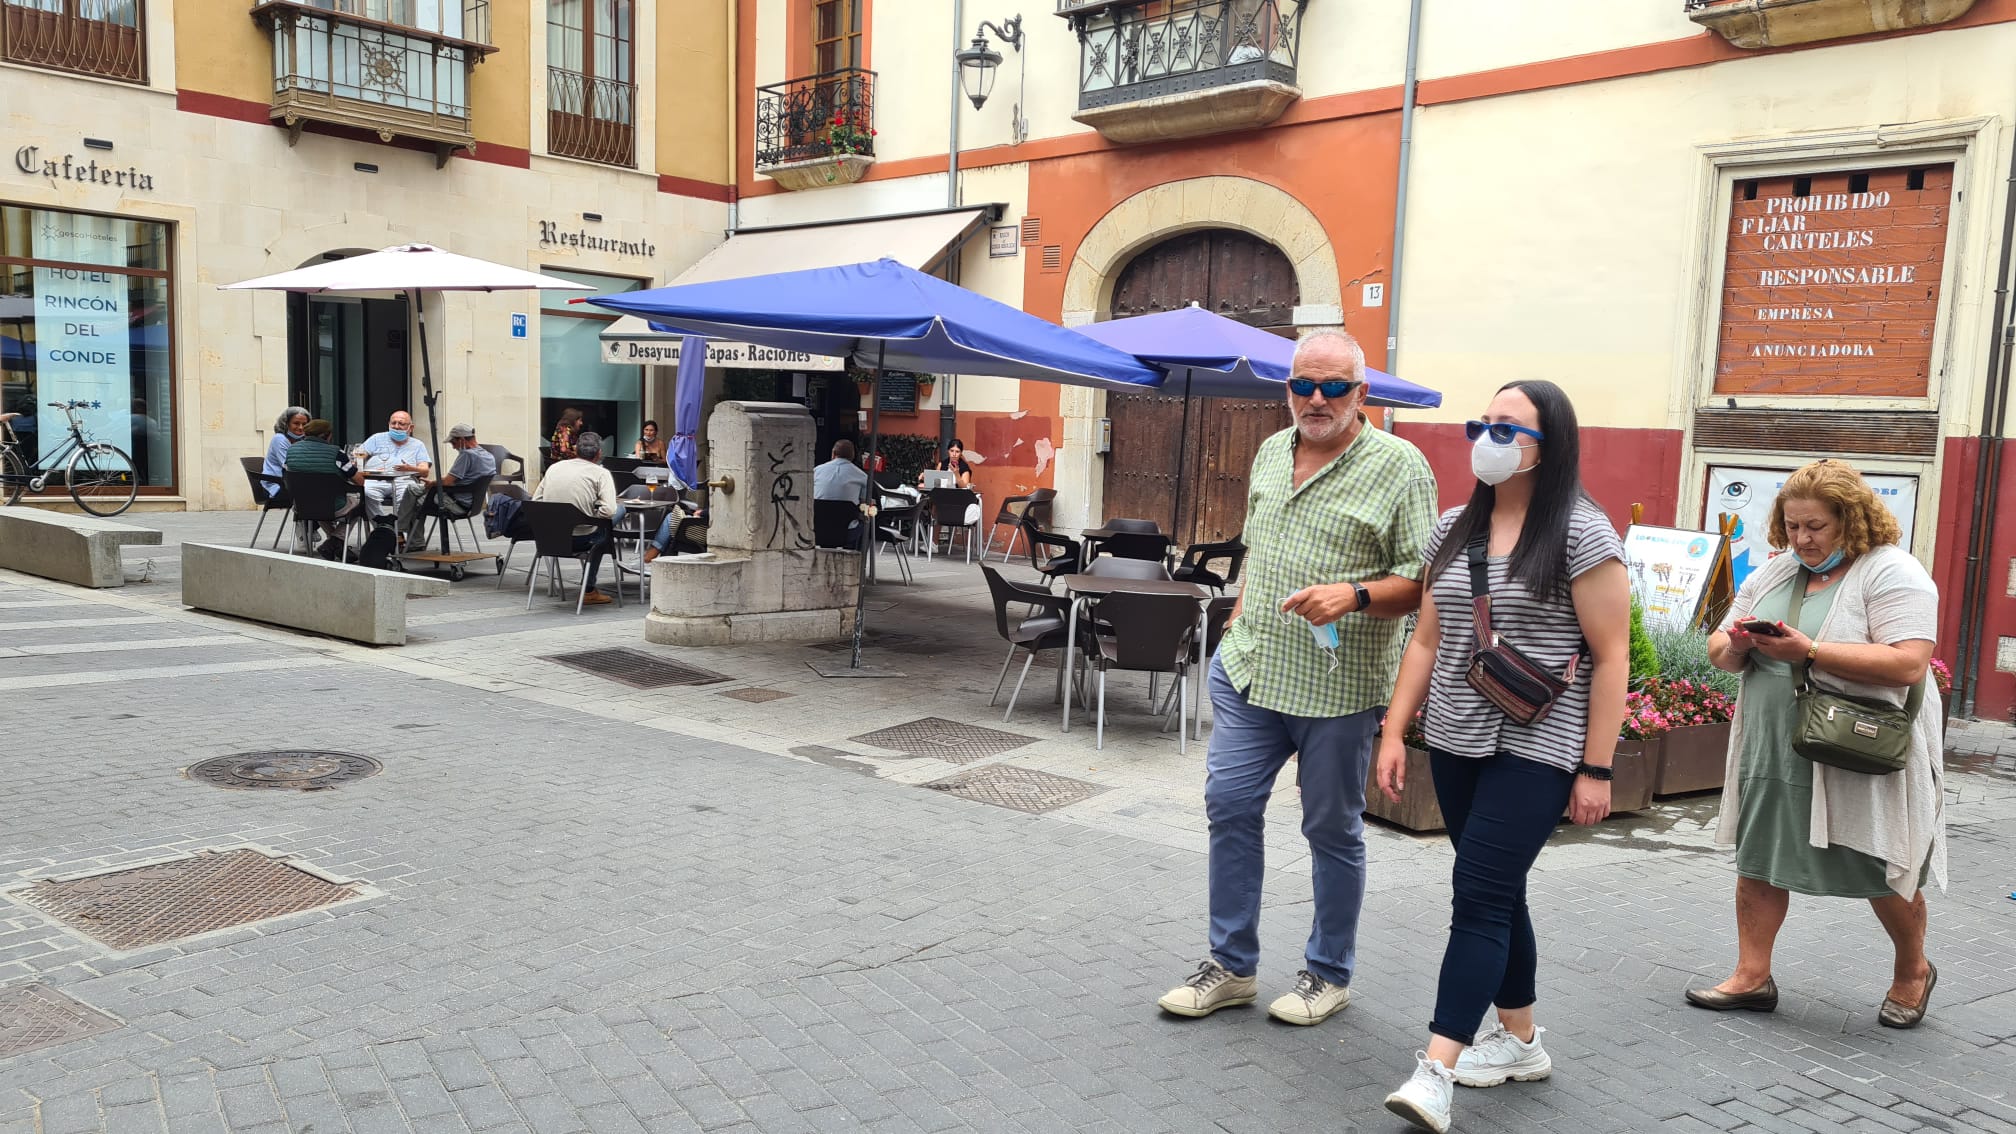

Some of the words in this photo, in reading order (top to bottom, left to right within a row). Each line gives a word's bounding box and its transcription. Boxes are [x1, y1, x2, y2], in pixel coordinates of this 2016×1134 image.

[15, 145, 154, 190] Cafeteria
[1766, 191, 1891, 214] PROHIBIDO
[1741, 215, 1807, 235] FIJAR
[539, 220, 656, 257] Restaurante
[1763, 230, 1874, 250] CARTELES
[1760, 265, 1915, 286] RESPONSABLE
[1369, 286, 1381, 299] 13
[44, 295, 118, 312] RINCÓN
[1757, 307, 1834, 320] EMPRESA
[65, 323, 100, 337] DEL
[49, 350, 117, 365] CONDE
[629, 342, 680, 361] Desayun
[747, 345, 811, 363] Raciones
[1751, 344, 1874, 357] ANUNCIADORA
